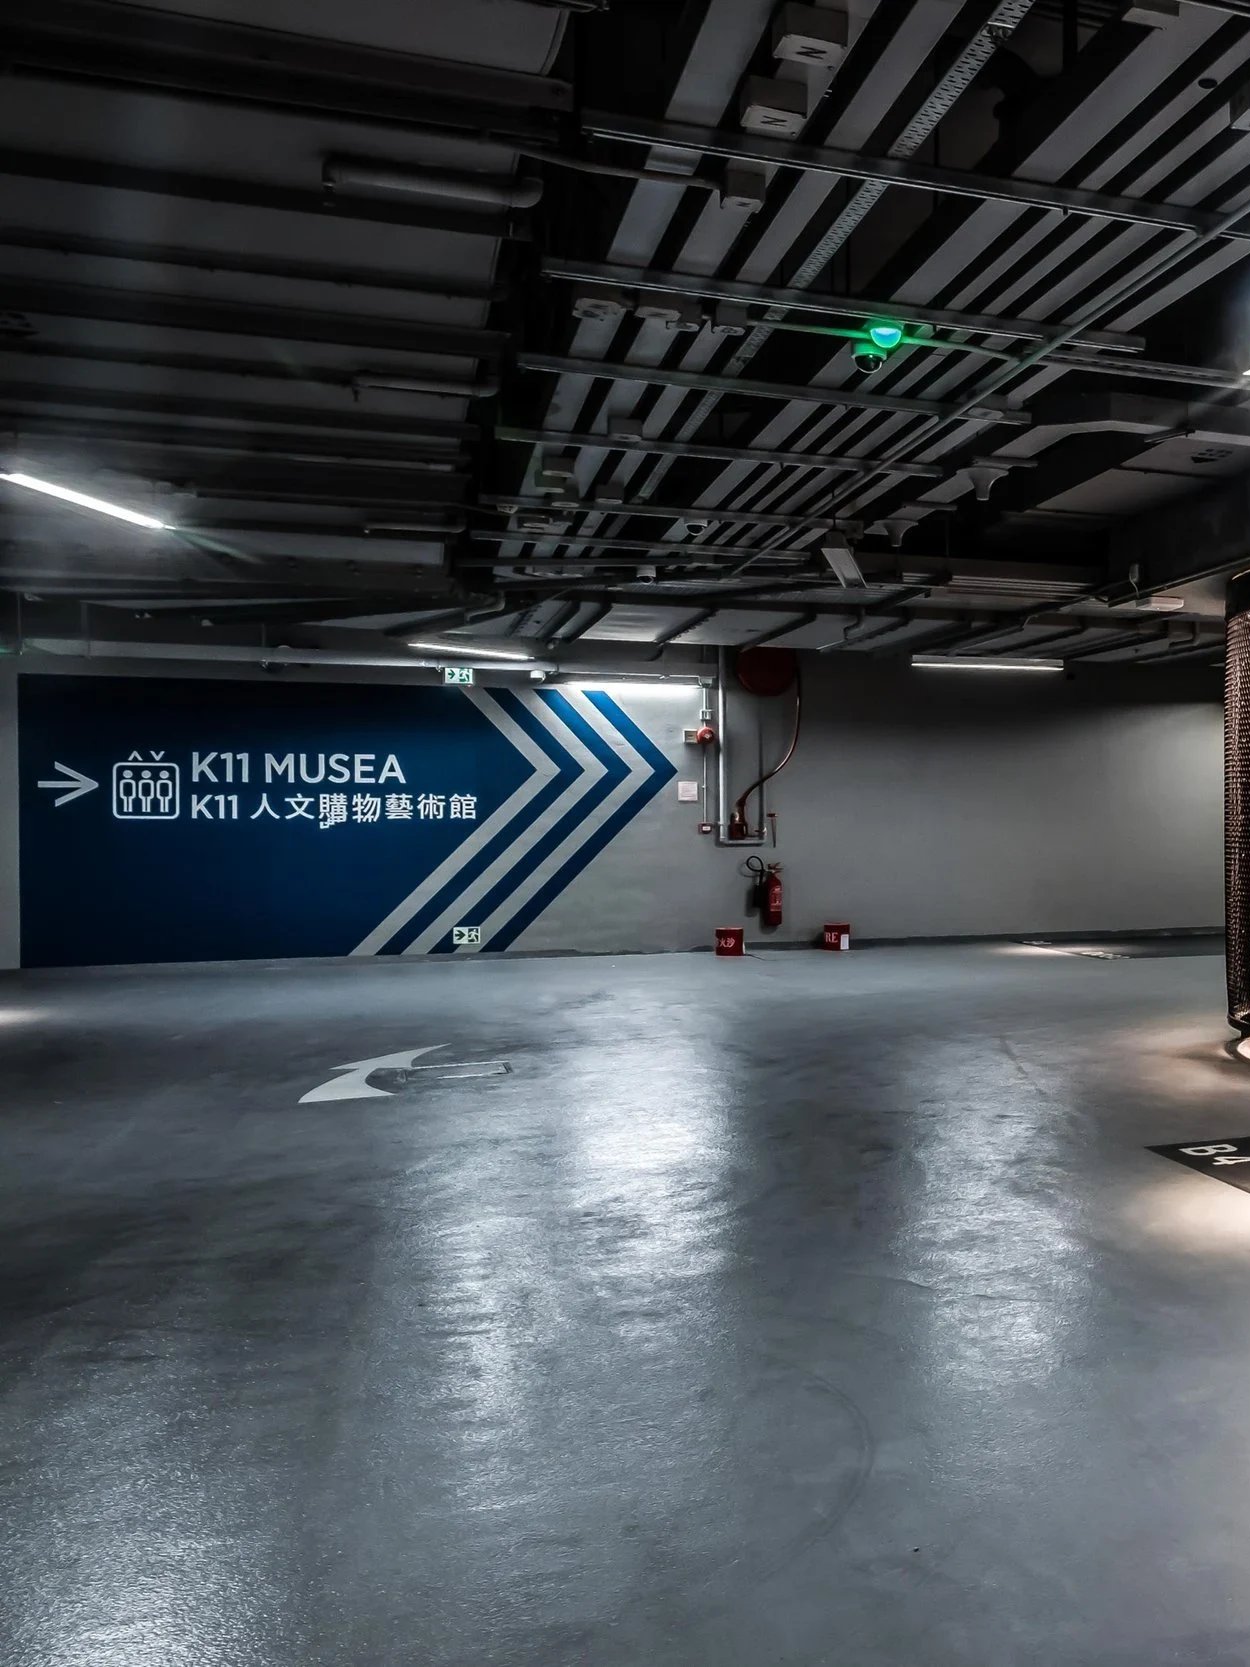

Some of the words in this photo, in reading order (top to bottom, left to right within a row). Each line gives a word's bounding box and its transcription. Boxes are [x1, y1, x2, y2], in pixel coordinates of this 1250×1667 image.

[191, 751, 249, 784] K11
[264, 753, 407, 784] MUSEA
[191, 794, 239, 820] K11
[250, 793, 478, 829] 人文購物藝術館
